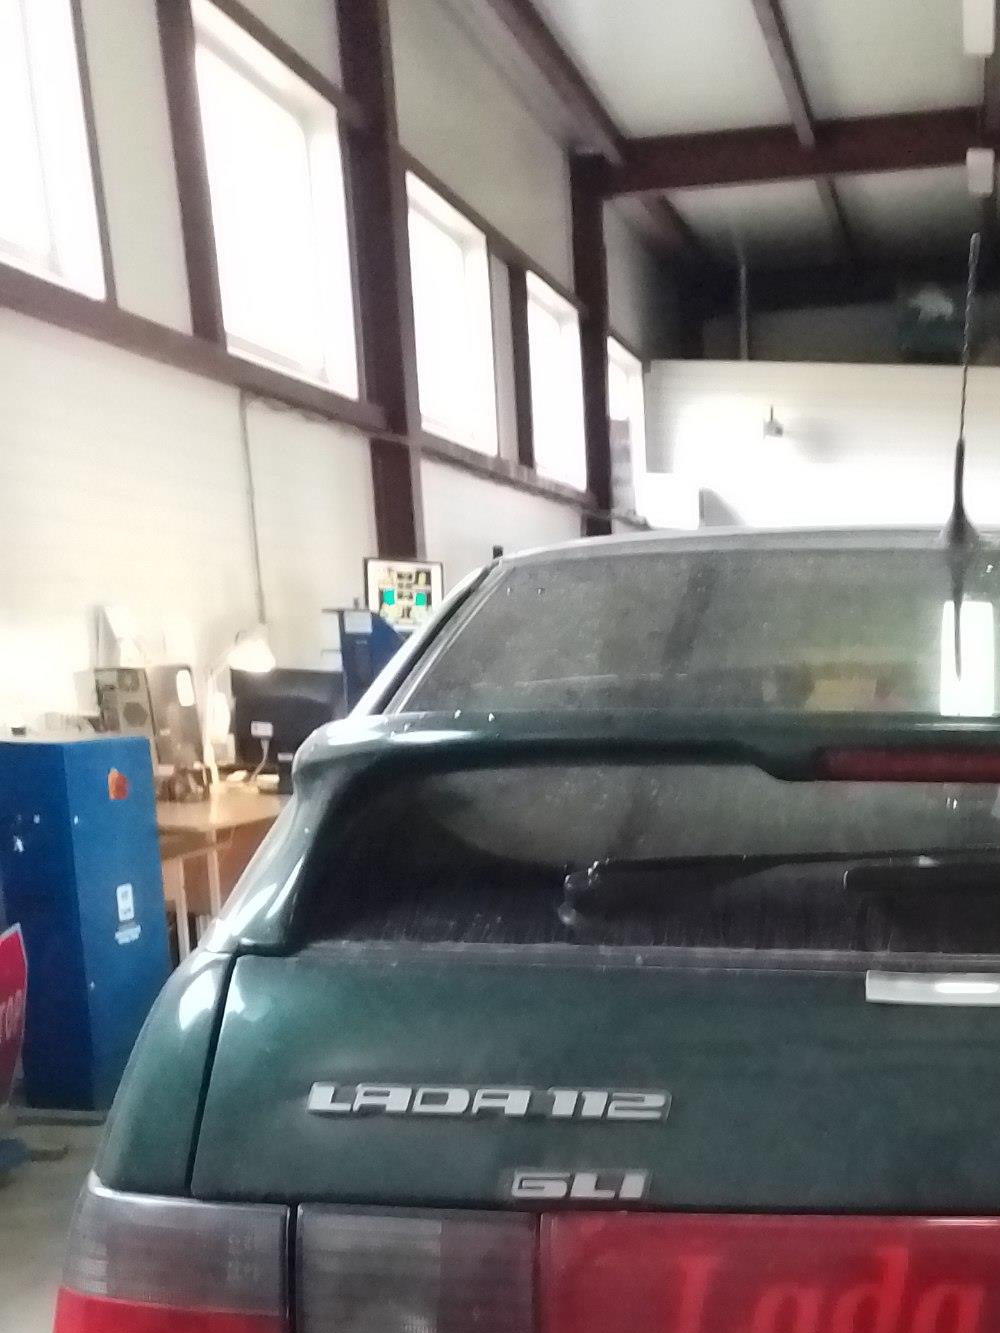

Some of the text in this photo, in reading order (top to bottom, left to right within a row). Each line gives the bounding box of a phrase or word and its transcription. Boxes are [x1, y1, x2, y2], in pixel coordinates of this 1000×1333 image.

[306, 1082, 671, 1121] LADA 112
[511, 1169, 650, 1201] GLI
